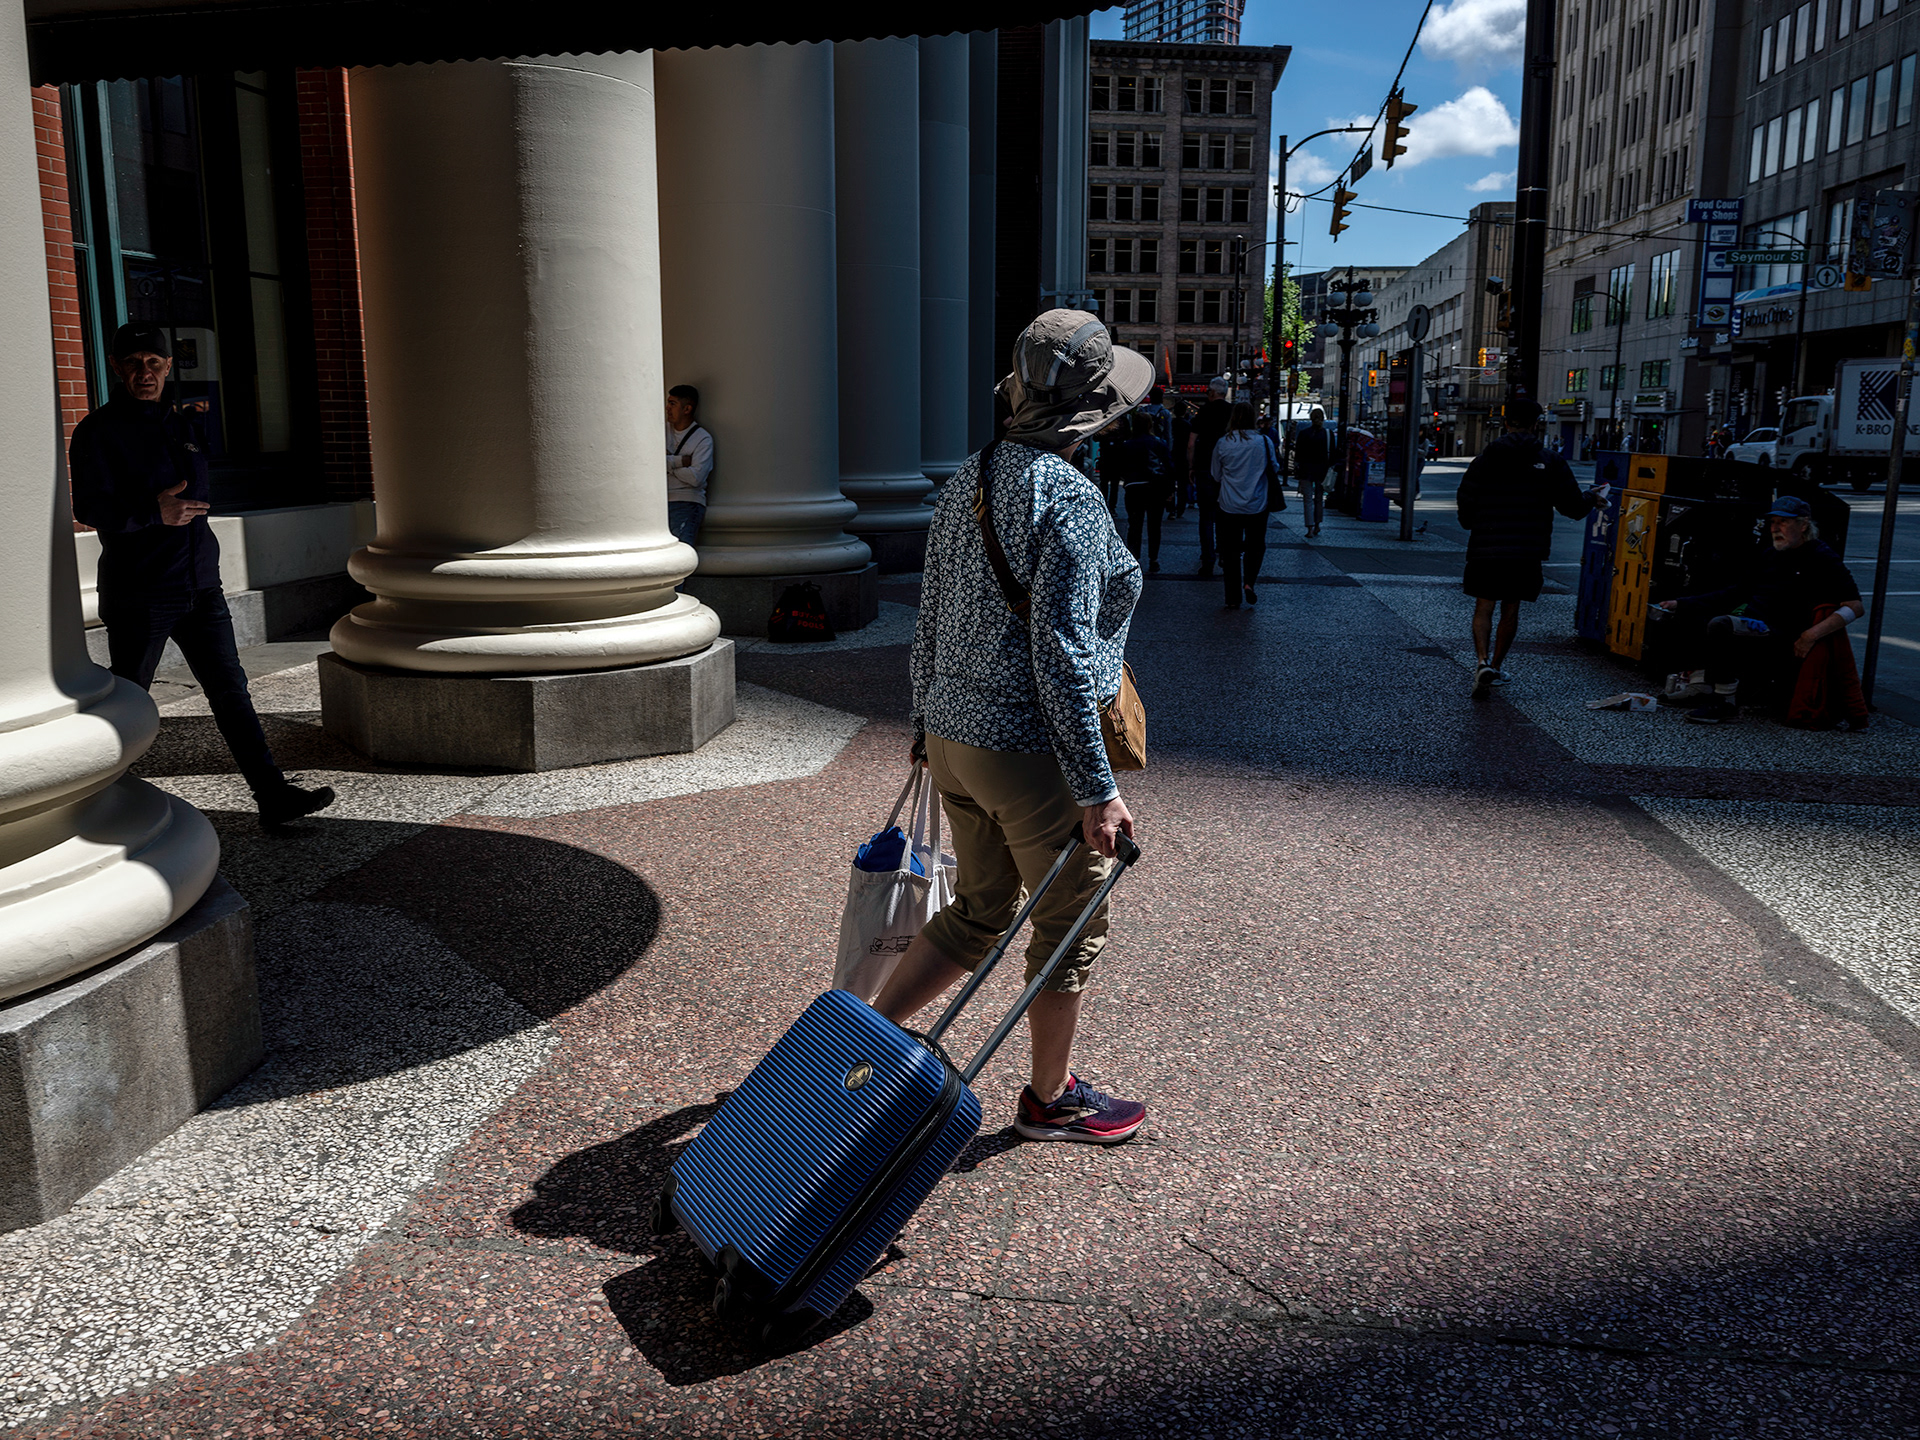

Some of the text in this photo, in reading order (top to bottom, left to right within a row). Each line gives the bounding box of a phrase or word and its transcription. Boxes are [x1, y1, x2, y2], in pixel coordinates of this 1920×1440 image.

[1692, 199, 1740, 210] Food Court
[1701, 210, 1739, 221] & Shops
[1730, 251, 1804, 263] Seymour St
